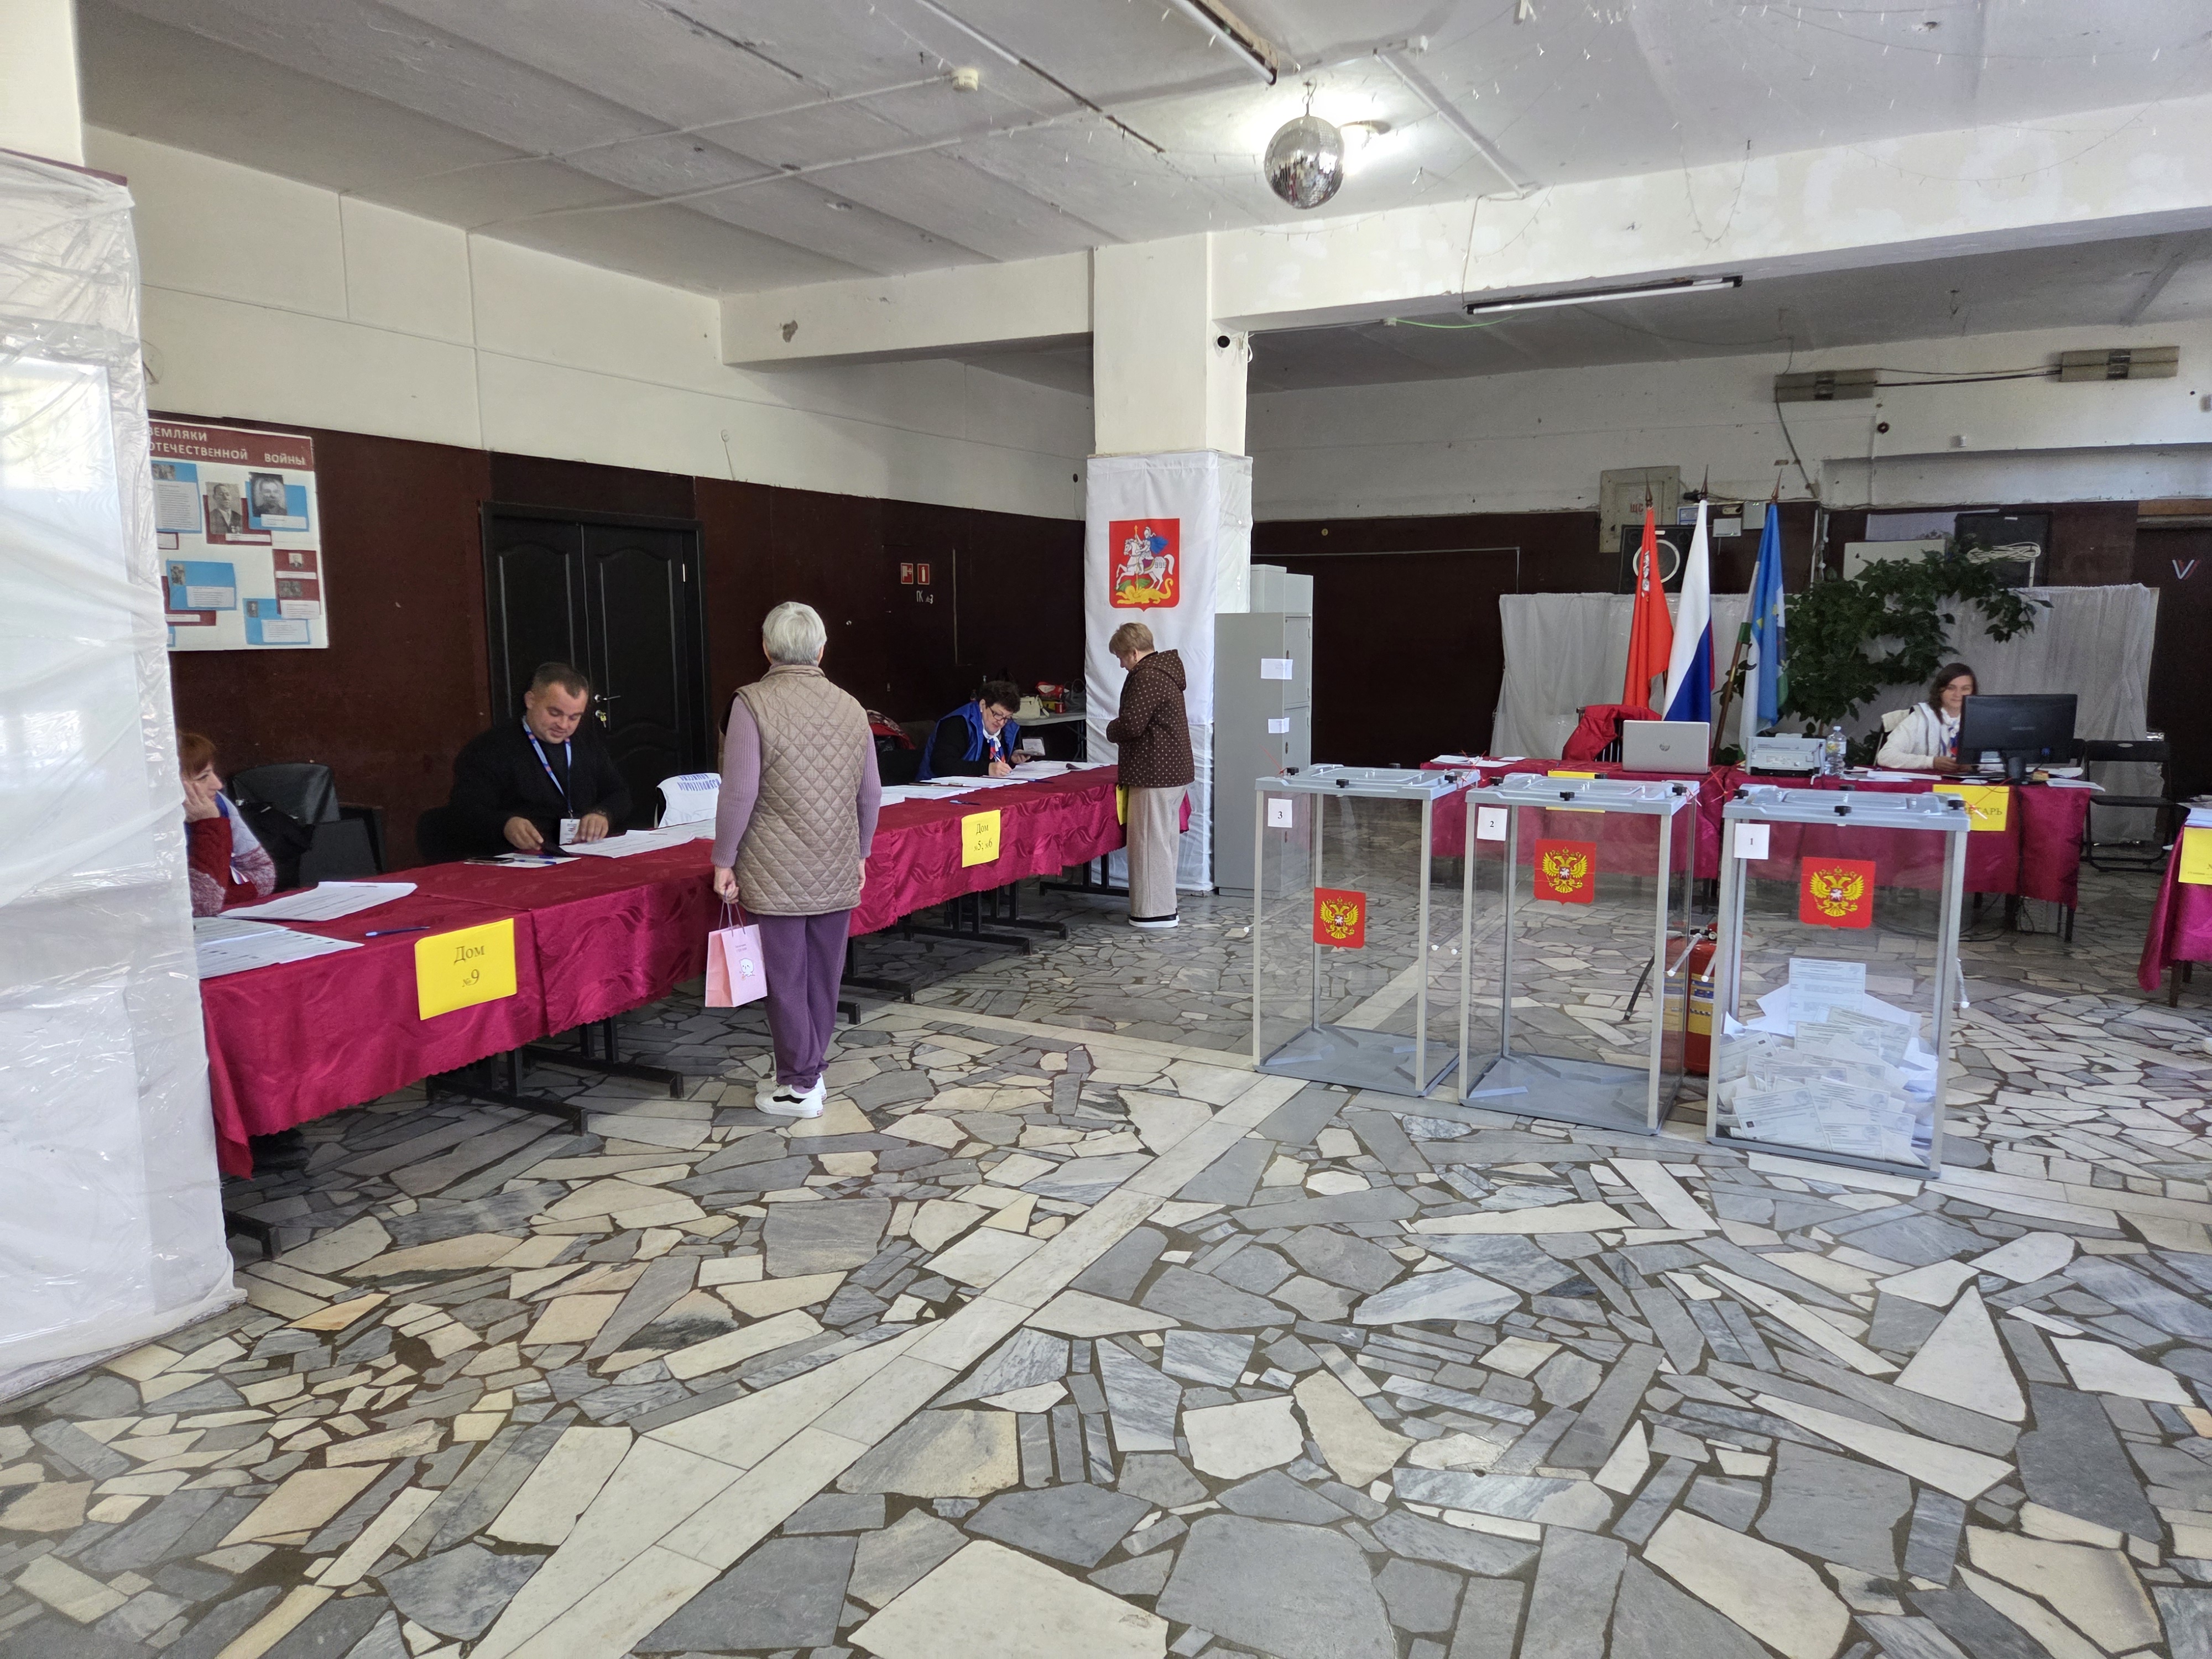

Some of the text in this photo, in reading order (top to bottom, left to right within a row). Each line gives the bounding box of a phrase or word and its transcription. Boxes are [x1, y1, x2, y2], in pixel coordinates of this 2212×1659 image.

[149, 442, 306, 465] ОТЕЧЕСТВЕННОЙ ВОЙНЫ
[1277, 811, 1283, 820] 3
[975, 823, 989, 836] Дом
[453, 945, 485, 966] Дом
